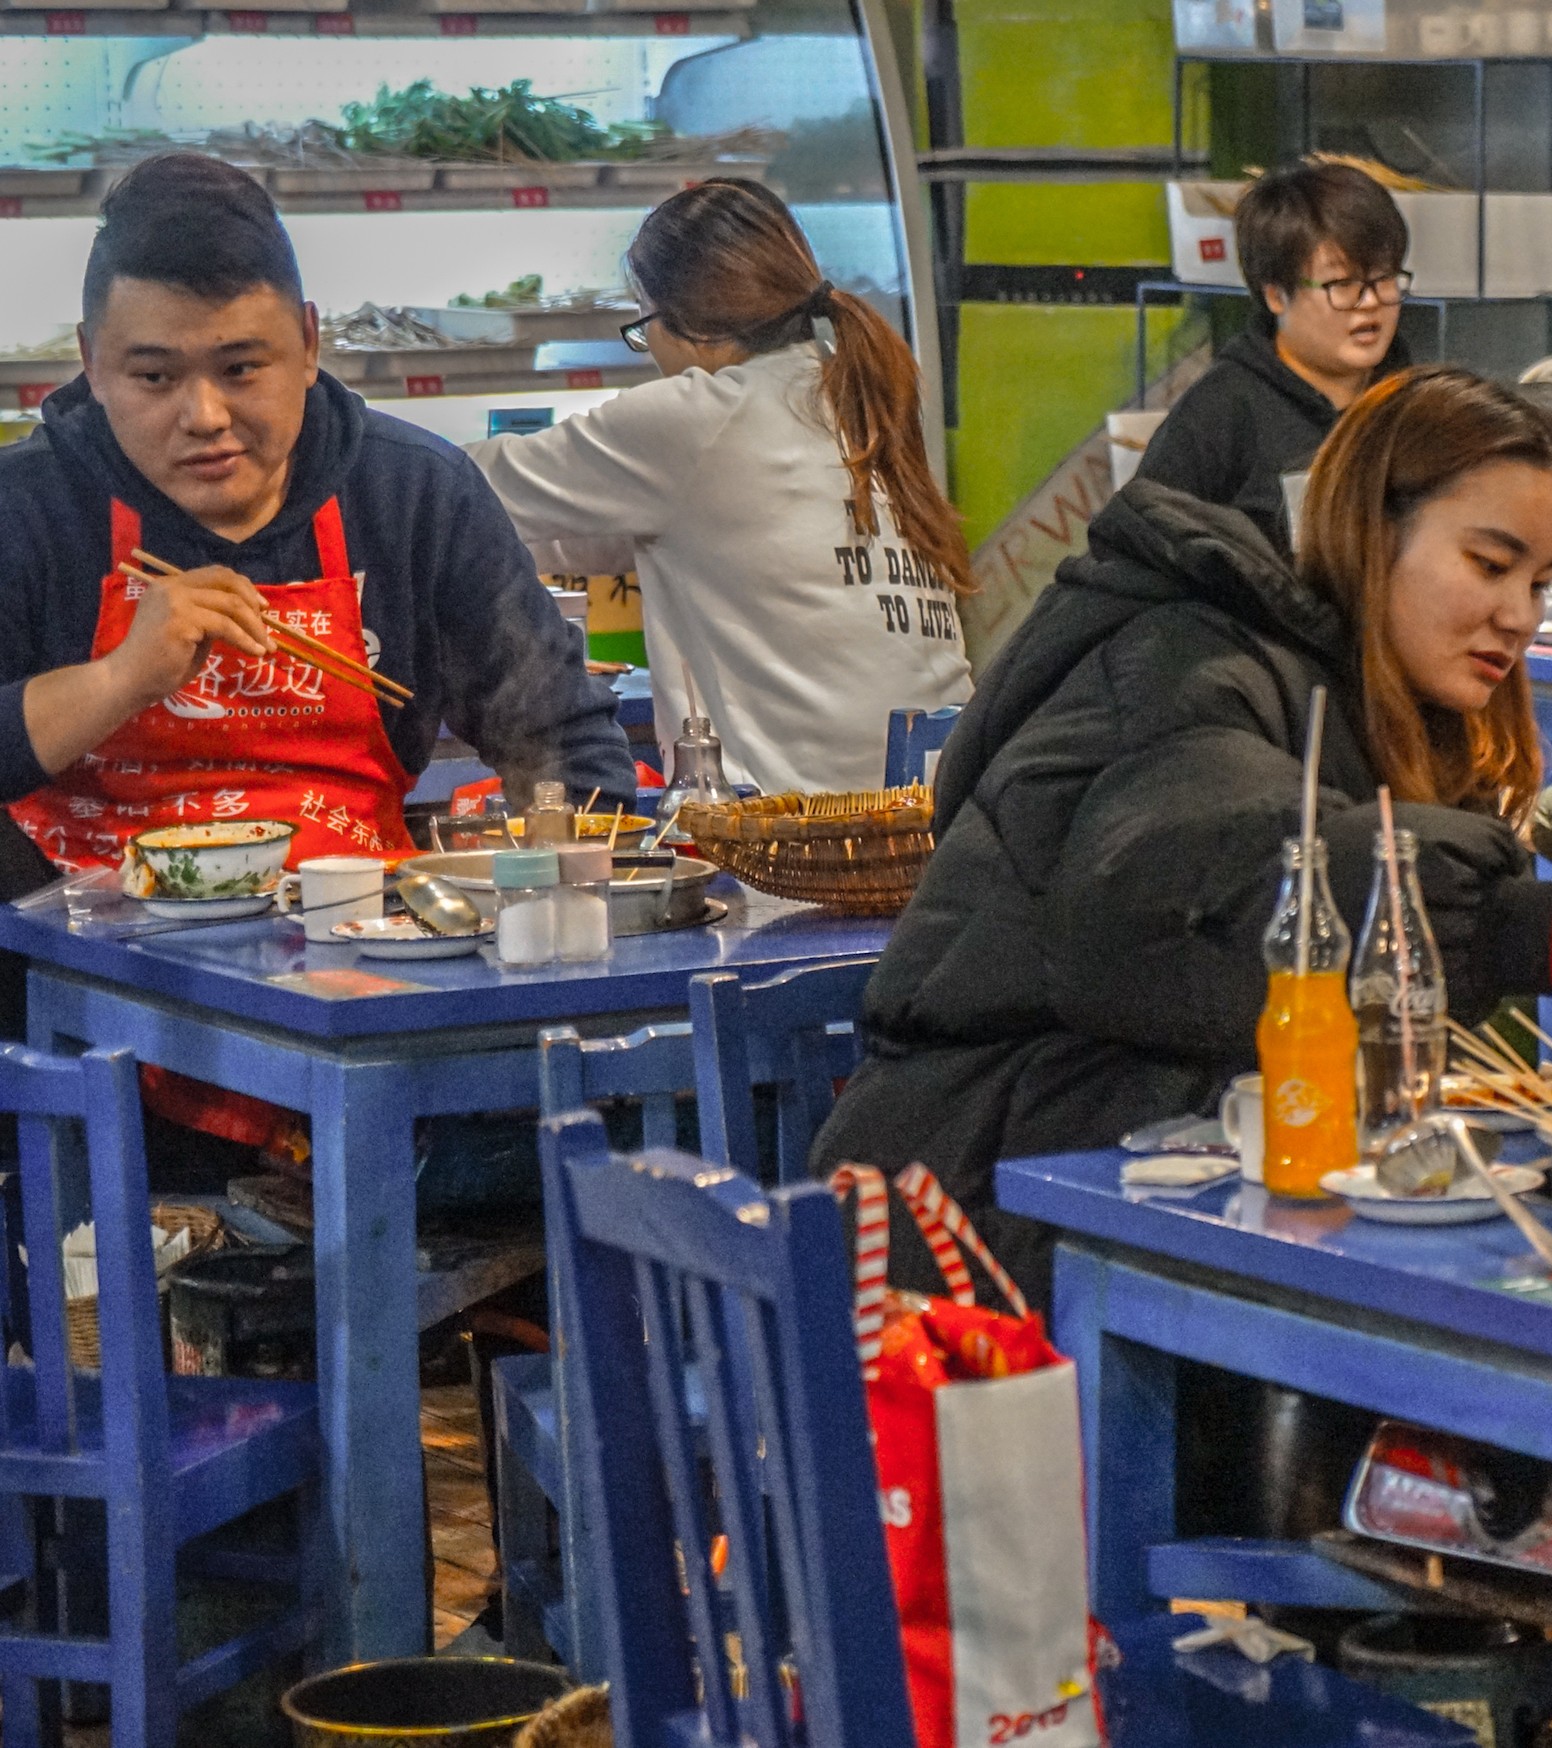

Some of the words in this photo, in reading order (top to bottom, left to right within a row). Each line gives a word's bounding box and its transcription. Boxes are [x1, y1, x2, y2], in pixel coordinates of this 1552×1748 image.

[834, 546, 872, 586] TO
[876, 594, 910, 634] TO
[917, 598, 957, 641] LIVE!
